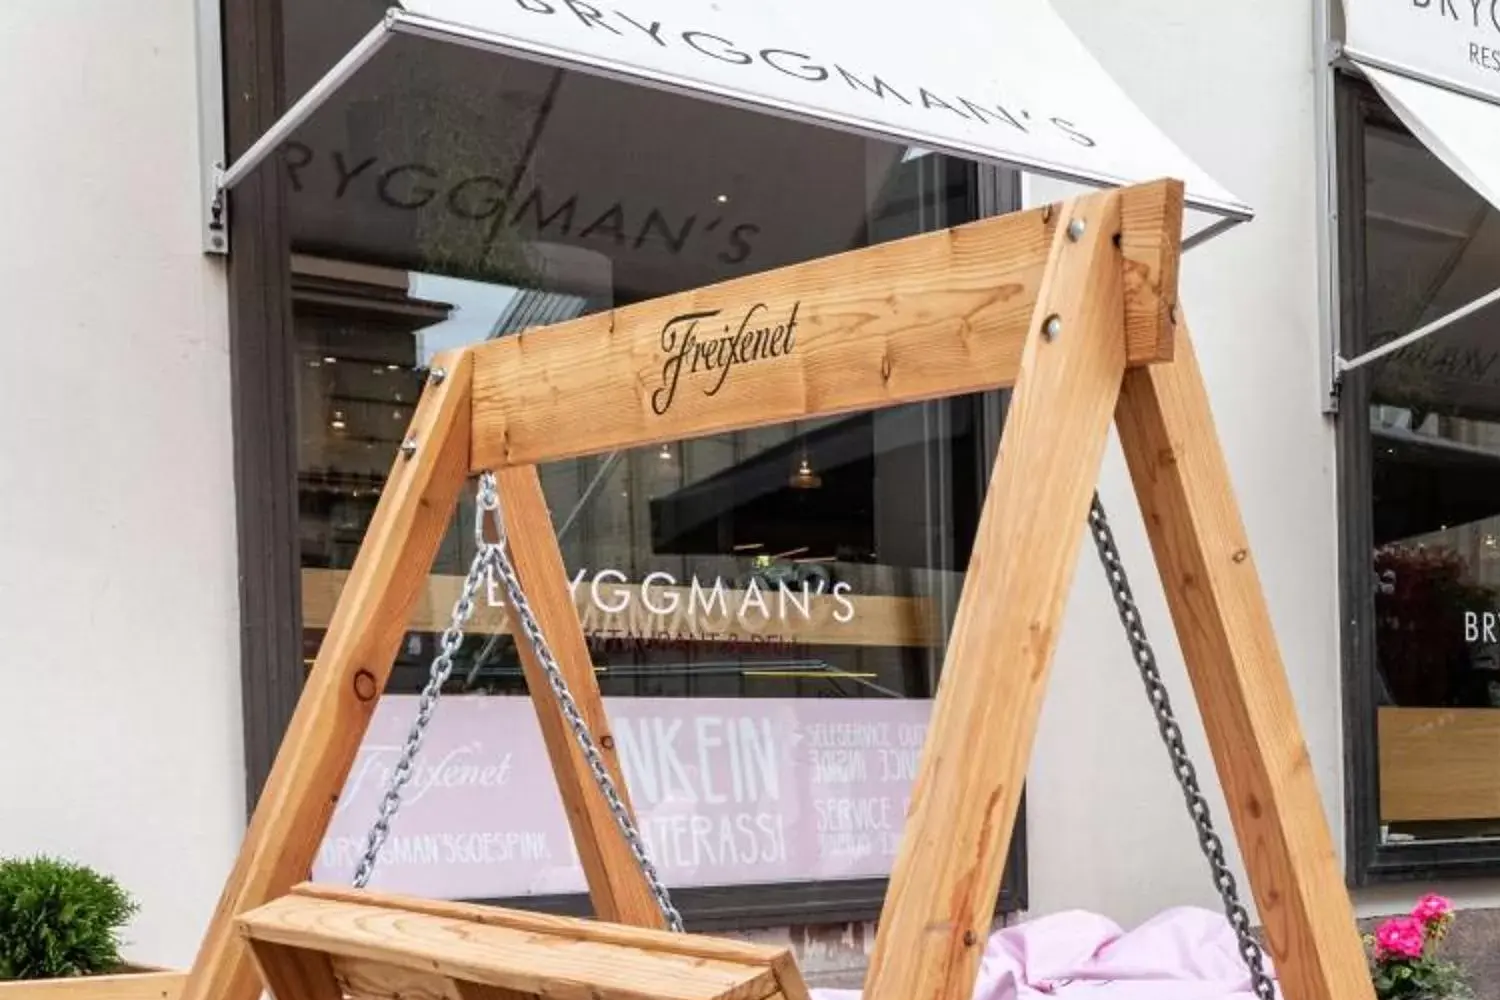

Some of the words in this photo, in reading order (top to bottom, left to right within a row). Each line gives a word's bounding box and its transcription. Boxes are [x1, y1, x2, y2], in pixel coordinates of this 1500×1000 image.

[651, 300, 801, 416] Freixenet
[486, 564, 855, 623] BYGGMAN'S
[813, 796, 893, 832] SERVICE
